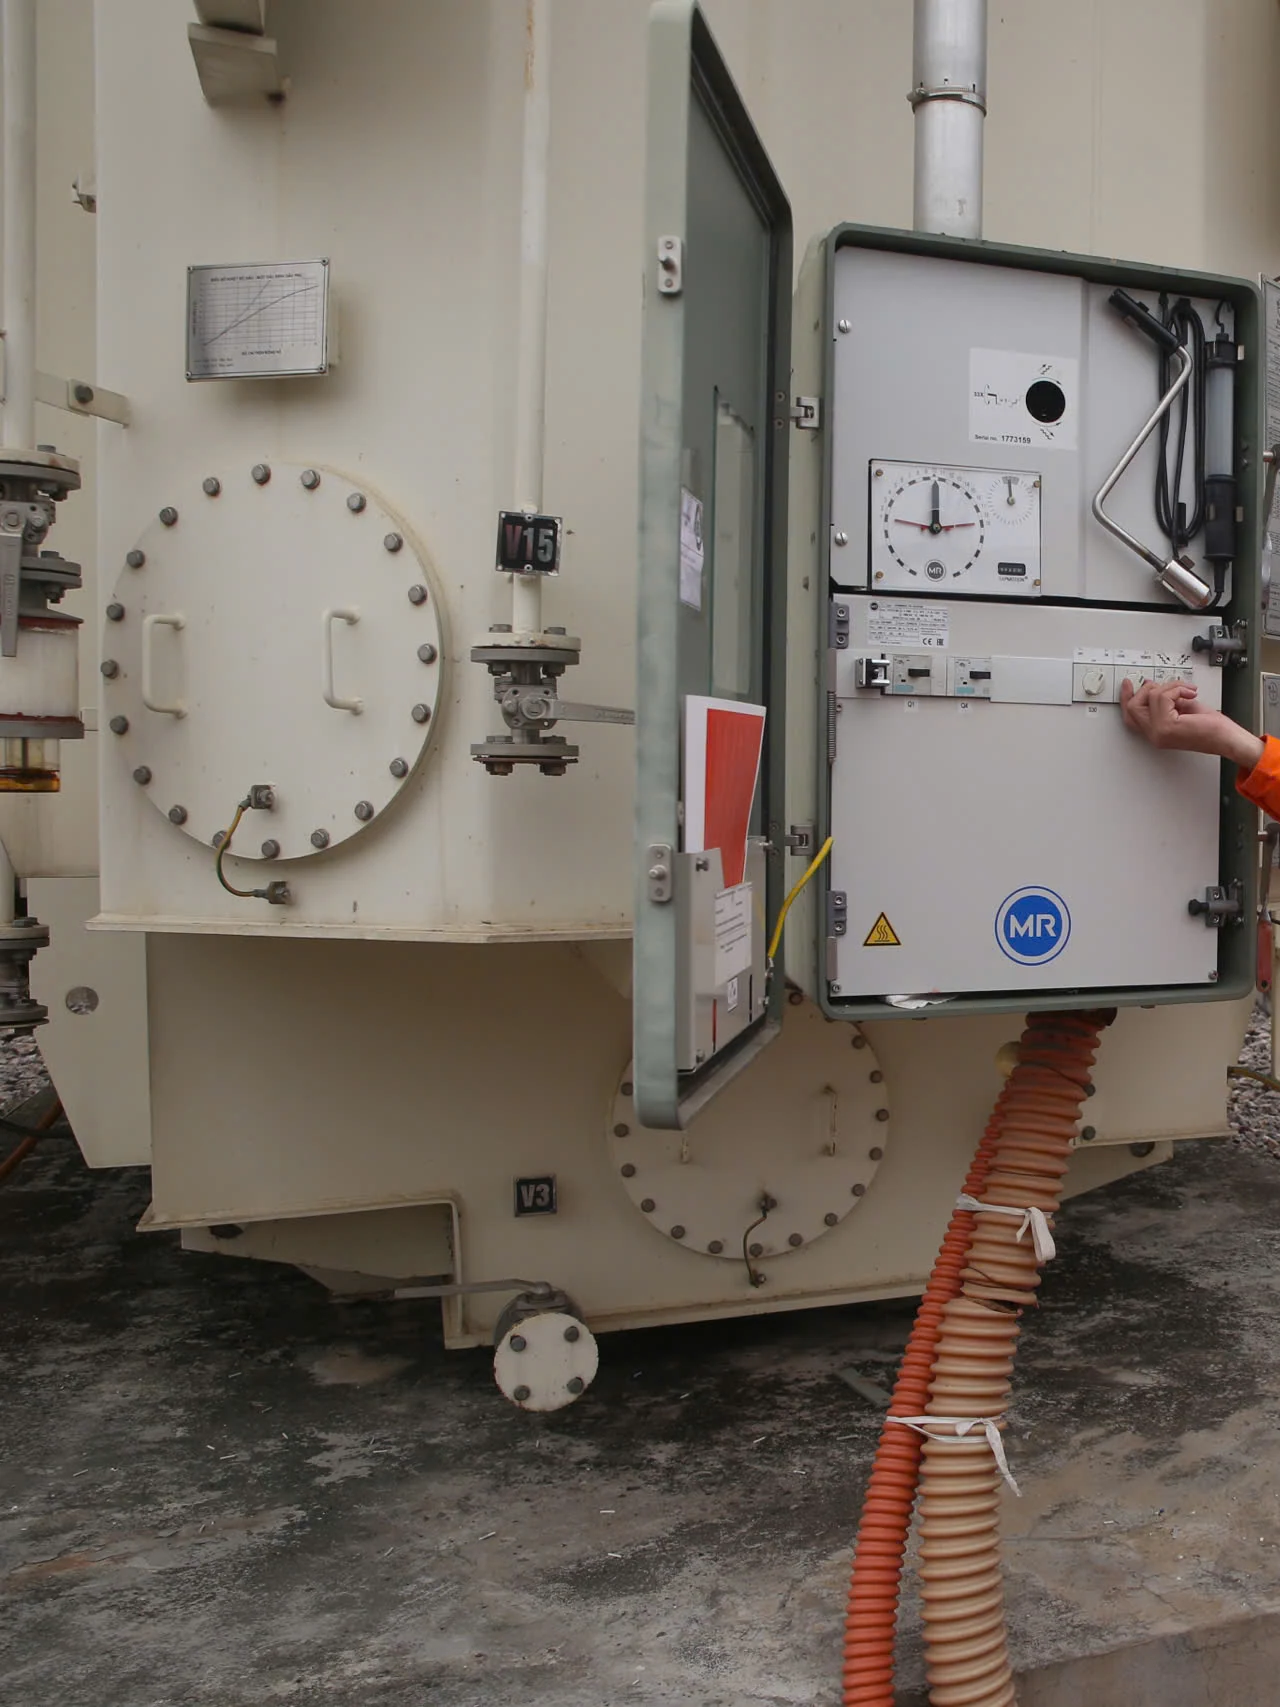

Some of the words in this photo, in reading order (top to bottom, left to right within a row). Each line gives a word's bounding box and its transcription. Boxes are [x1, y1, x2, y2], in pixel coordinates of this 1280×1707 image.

[1001, 435, 1031, 444] 1773159
[505, 524, 554, 562] V15
[1009, 913, 1057, 938] MR
[520, 1183, 550, 1208] V3
